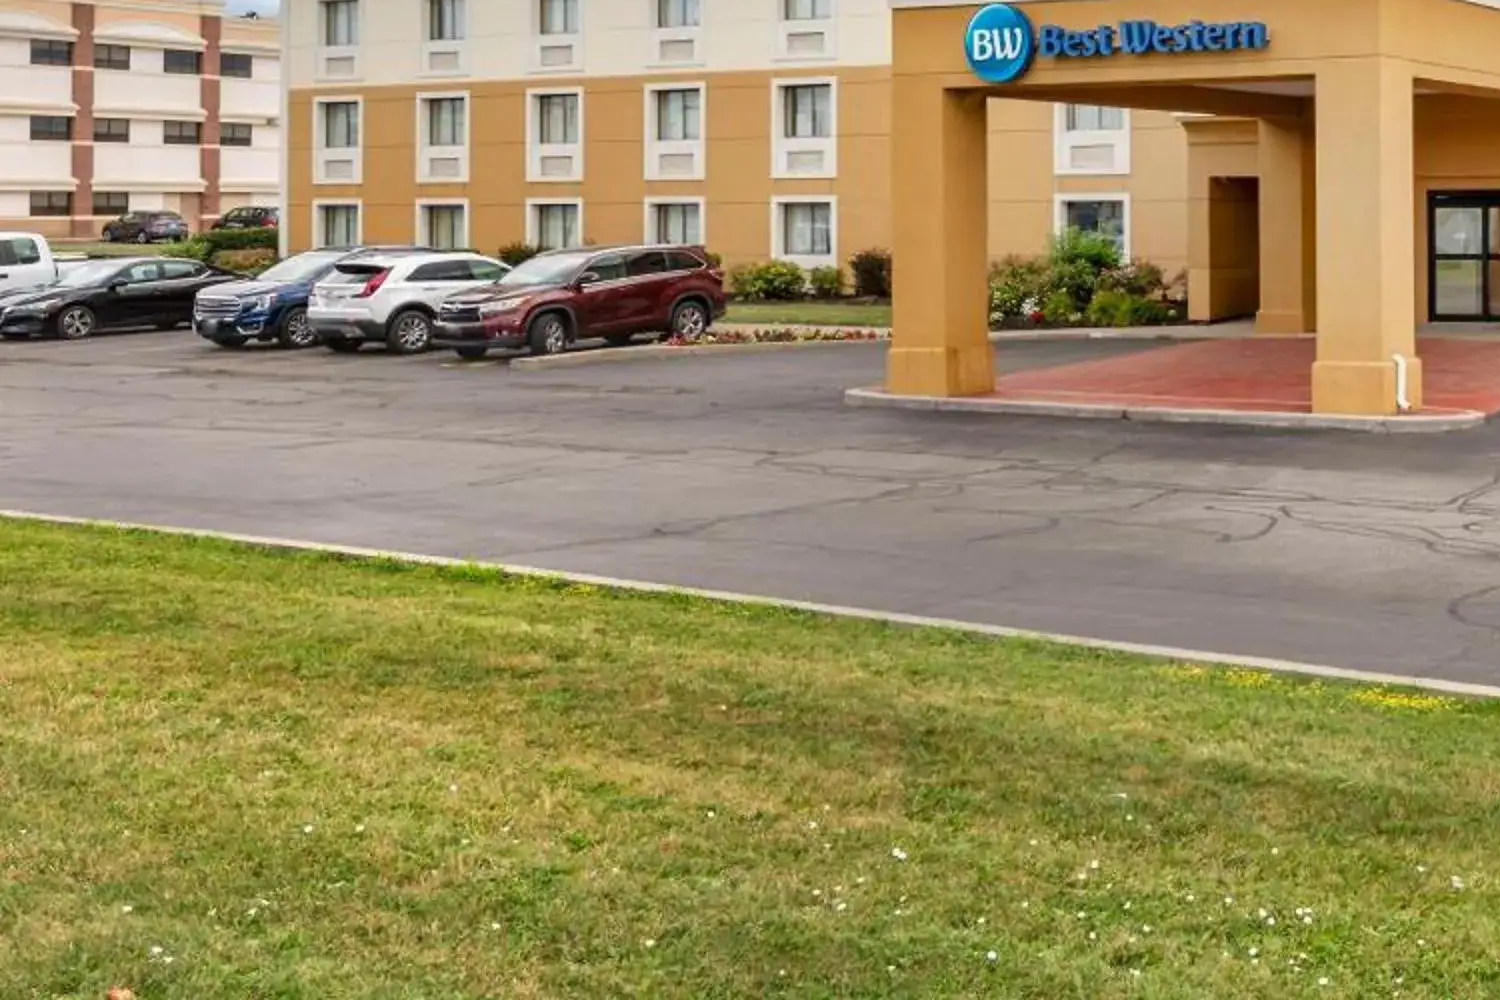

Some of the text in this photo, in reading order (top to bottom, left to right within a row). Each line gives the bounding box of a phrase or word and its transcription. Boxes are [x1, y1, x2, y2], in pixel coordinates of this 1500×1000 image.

[973, 27, 1022, 61] BW
[1039, 20, 1267, 57] Best Western
